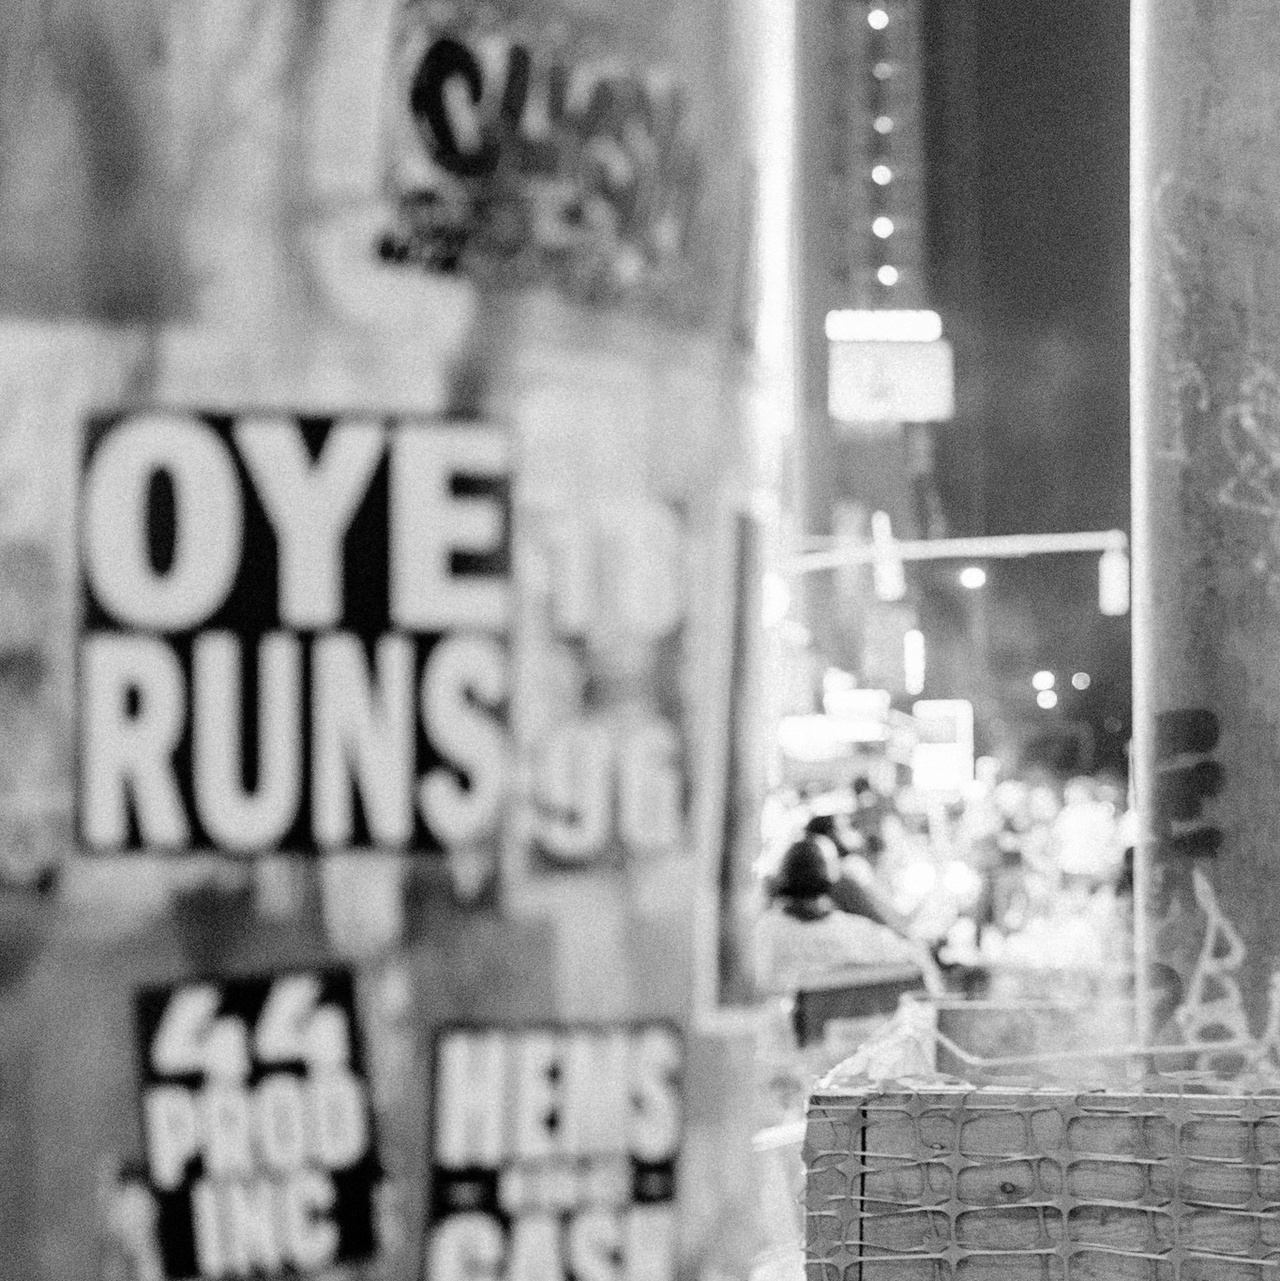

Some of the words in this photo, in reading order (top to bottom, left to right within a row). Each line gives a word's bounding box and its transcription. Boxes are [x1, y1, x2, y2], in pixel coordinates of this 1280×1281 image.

[83, 415, 511, 628] OYE
[83, 635, 509, 850] RUNS
[194, 1170, 338, 1275] INC
